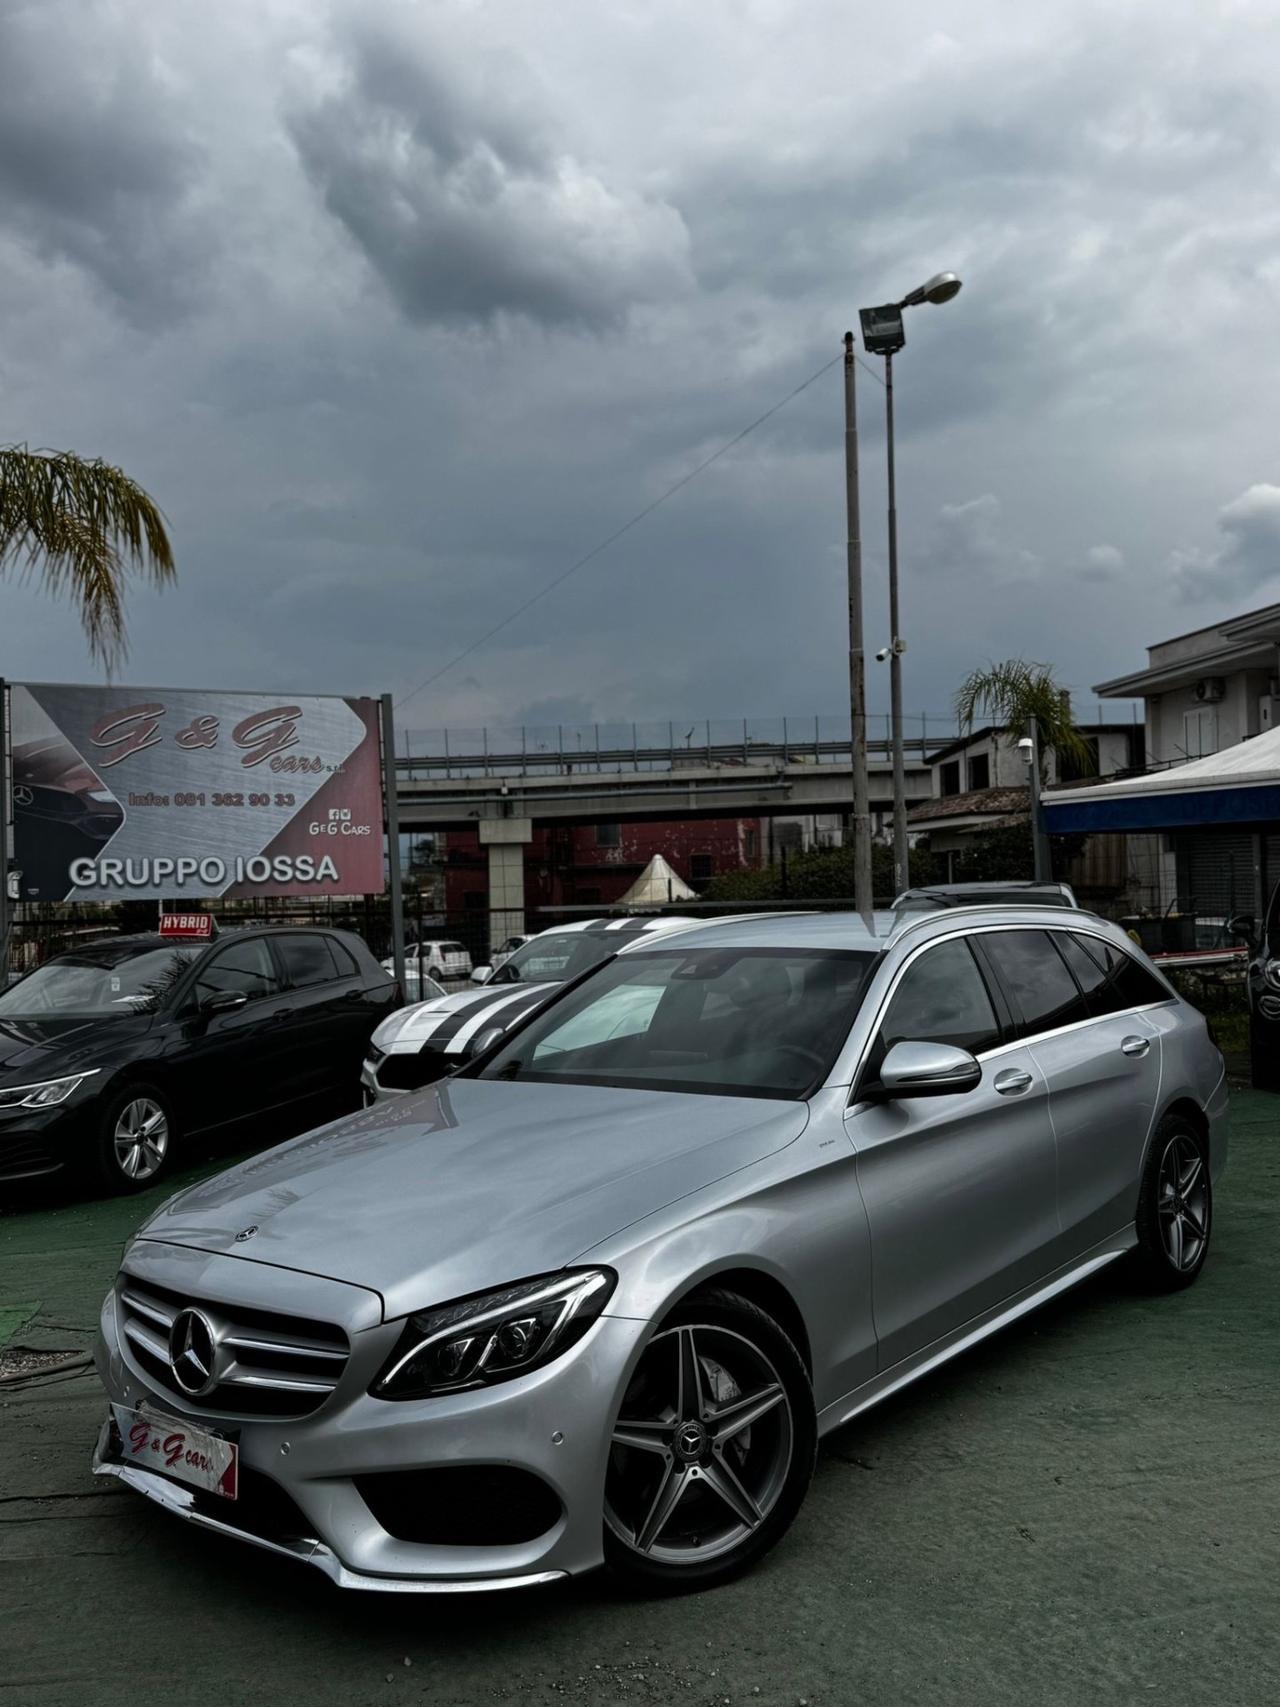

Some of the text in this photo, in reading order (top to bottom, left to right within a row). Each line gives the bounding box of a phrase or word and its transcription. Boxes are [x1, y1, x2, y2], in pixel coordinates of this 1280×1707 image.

[89, 703, 166, 767] G
[174, 715, 219, 749] &
[231, 706, 304, 767] G
[128, 792, 296, 807] Info: 081 362 90 33
[68, 854, 340, 887] GRUPPO IOSSA
[163, 916, 209, 929] HYBRID
[129, 1423, 151, 1455] G
[151, 1438, 161, 1453] &
[163, 1433, 185, 1467] G
